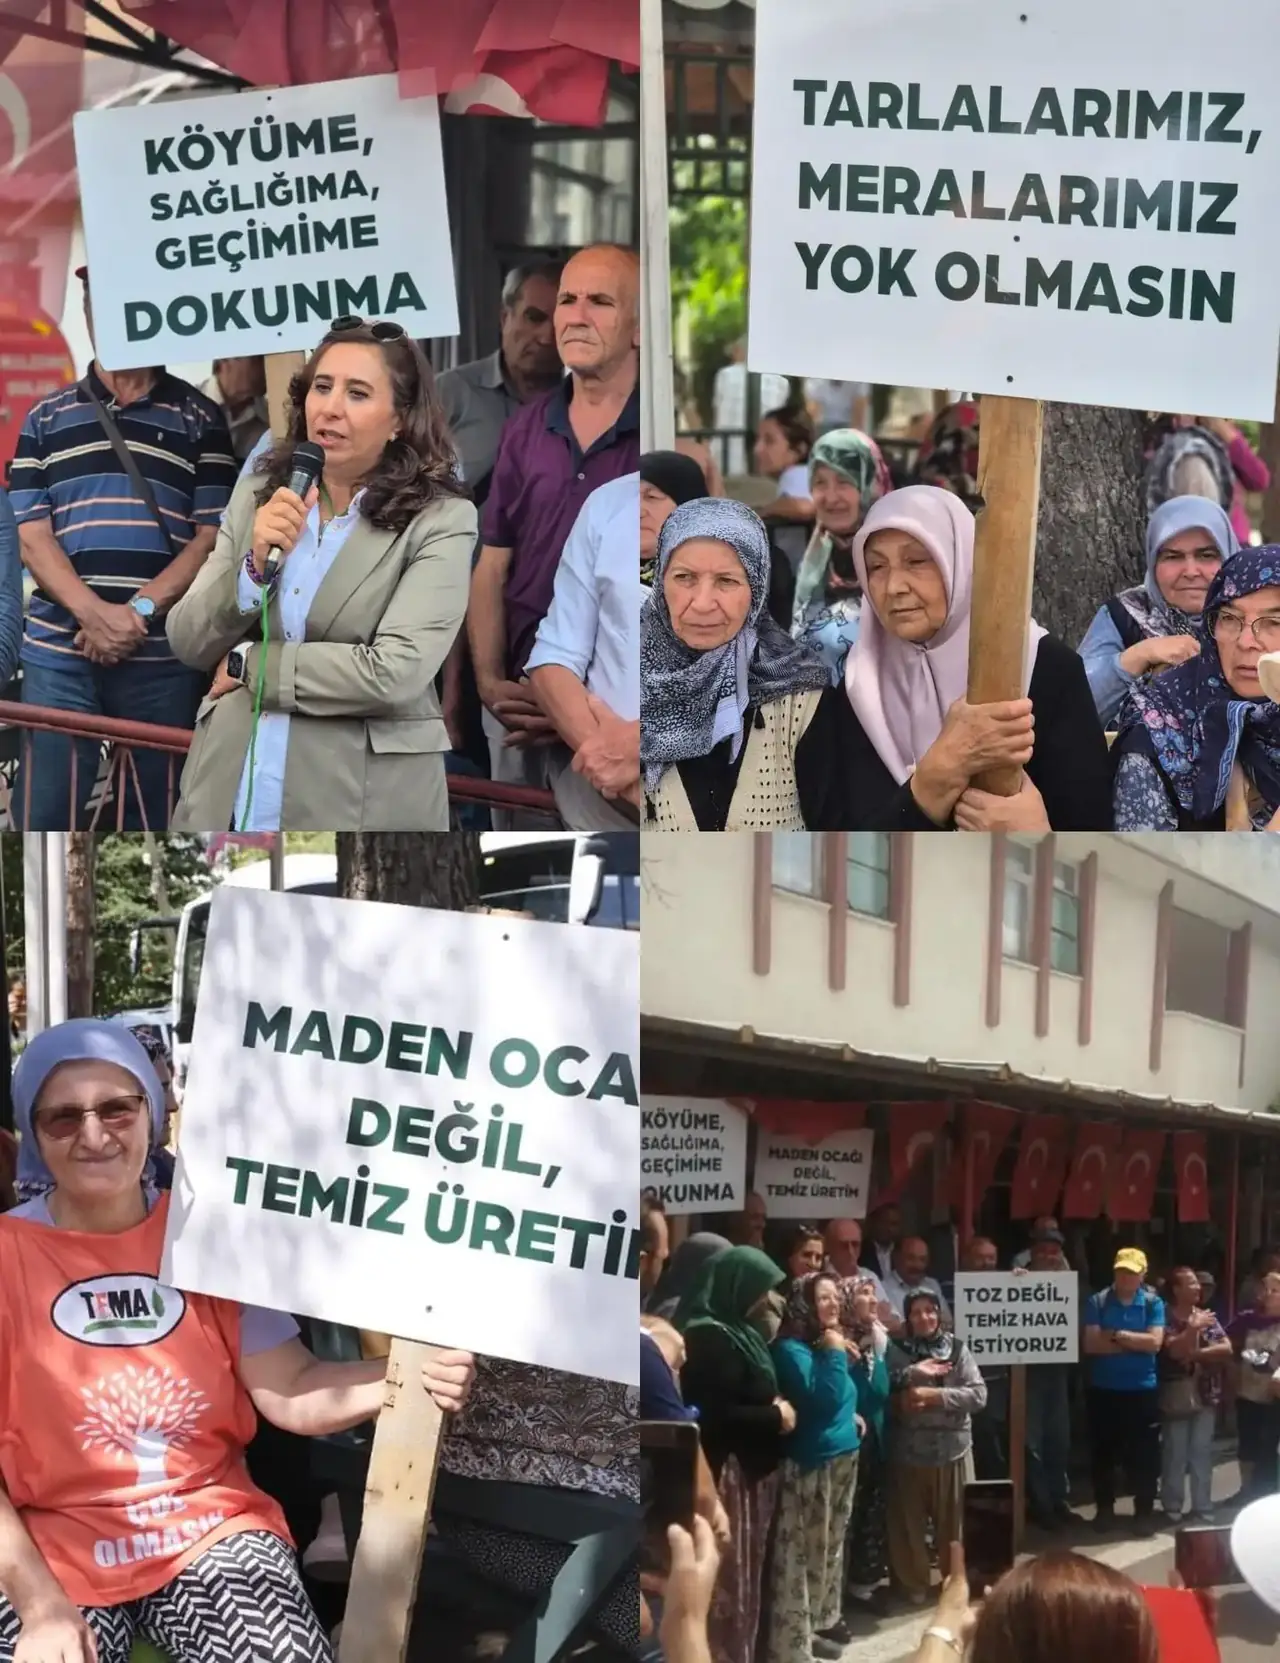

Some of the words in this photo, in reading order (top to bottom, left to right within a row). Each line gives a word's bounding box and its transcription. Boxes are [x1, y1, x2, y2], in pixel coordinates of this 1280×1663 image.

[793, 79, 1262, 154] TARLALARIMIZ,
[144, 114, 373, 175] KÖYÜME,
[150, 169, 379, 221] SAĞLIĞIMA,
[799, 162, 1238, 235] MERALARIMIZ
[155, 212, 379, 272] GEÇİMİME
[124, 271, 427, 342] DOKUNMA
[794, 242, 917, 297] YOK
[935, 251, 1236, 324] OLMASIN
[242, 1001, 473, 1080] MADEN
[345, 1097, 562, 1188] DEĞİL,
[641, 1108, 725, 1132] KÖYÜME,
[641, 1134, 724, 1152] SAĞLIĞIMA,
[641, 1153, 722, 1177] GEÇİMİME
[768, 1147, 819, 1162] MADEN
[822, 1149, 863, 1163] OCAĞI
[226, 1156, 410, 1235] TEMİZ
[766, 1182, 808, 1197] TEMİZ
[811, 1184, 859, 1198] ÜRETİM
[80, 1288, 150, 1319] TEMA
[963, 1288, 1002, 1303] TOZ
[1007, 1282, 1069, 1304] DEĞİL,
[965, 1309, 1018, 1327] TEMİZ
[1022, 1312, 1068, 1327] HAVA
[967, 1334, 1067, 1353] İSTİYORUZ
